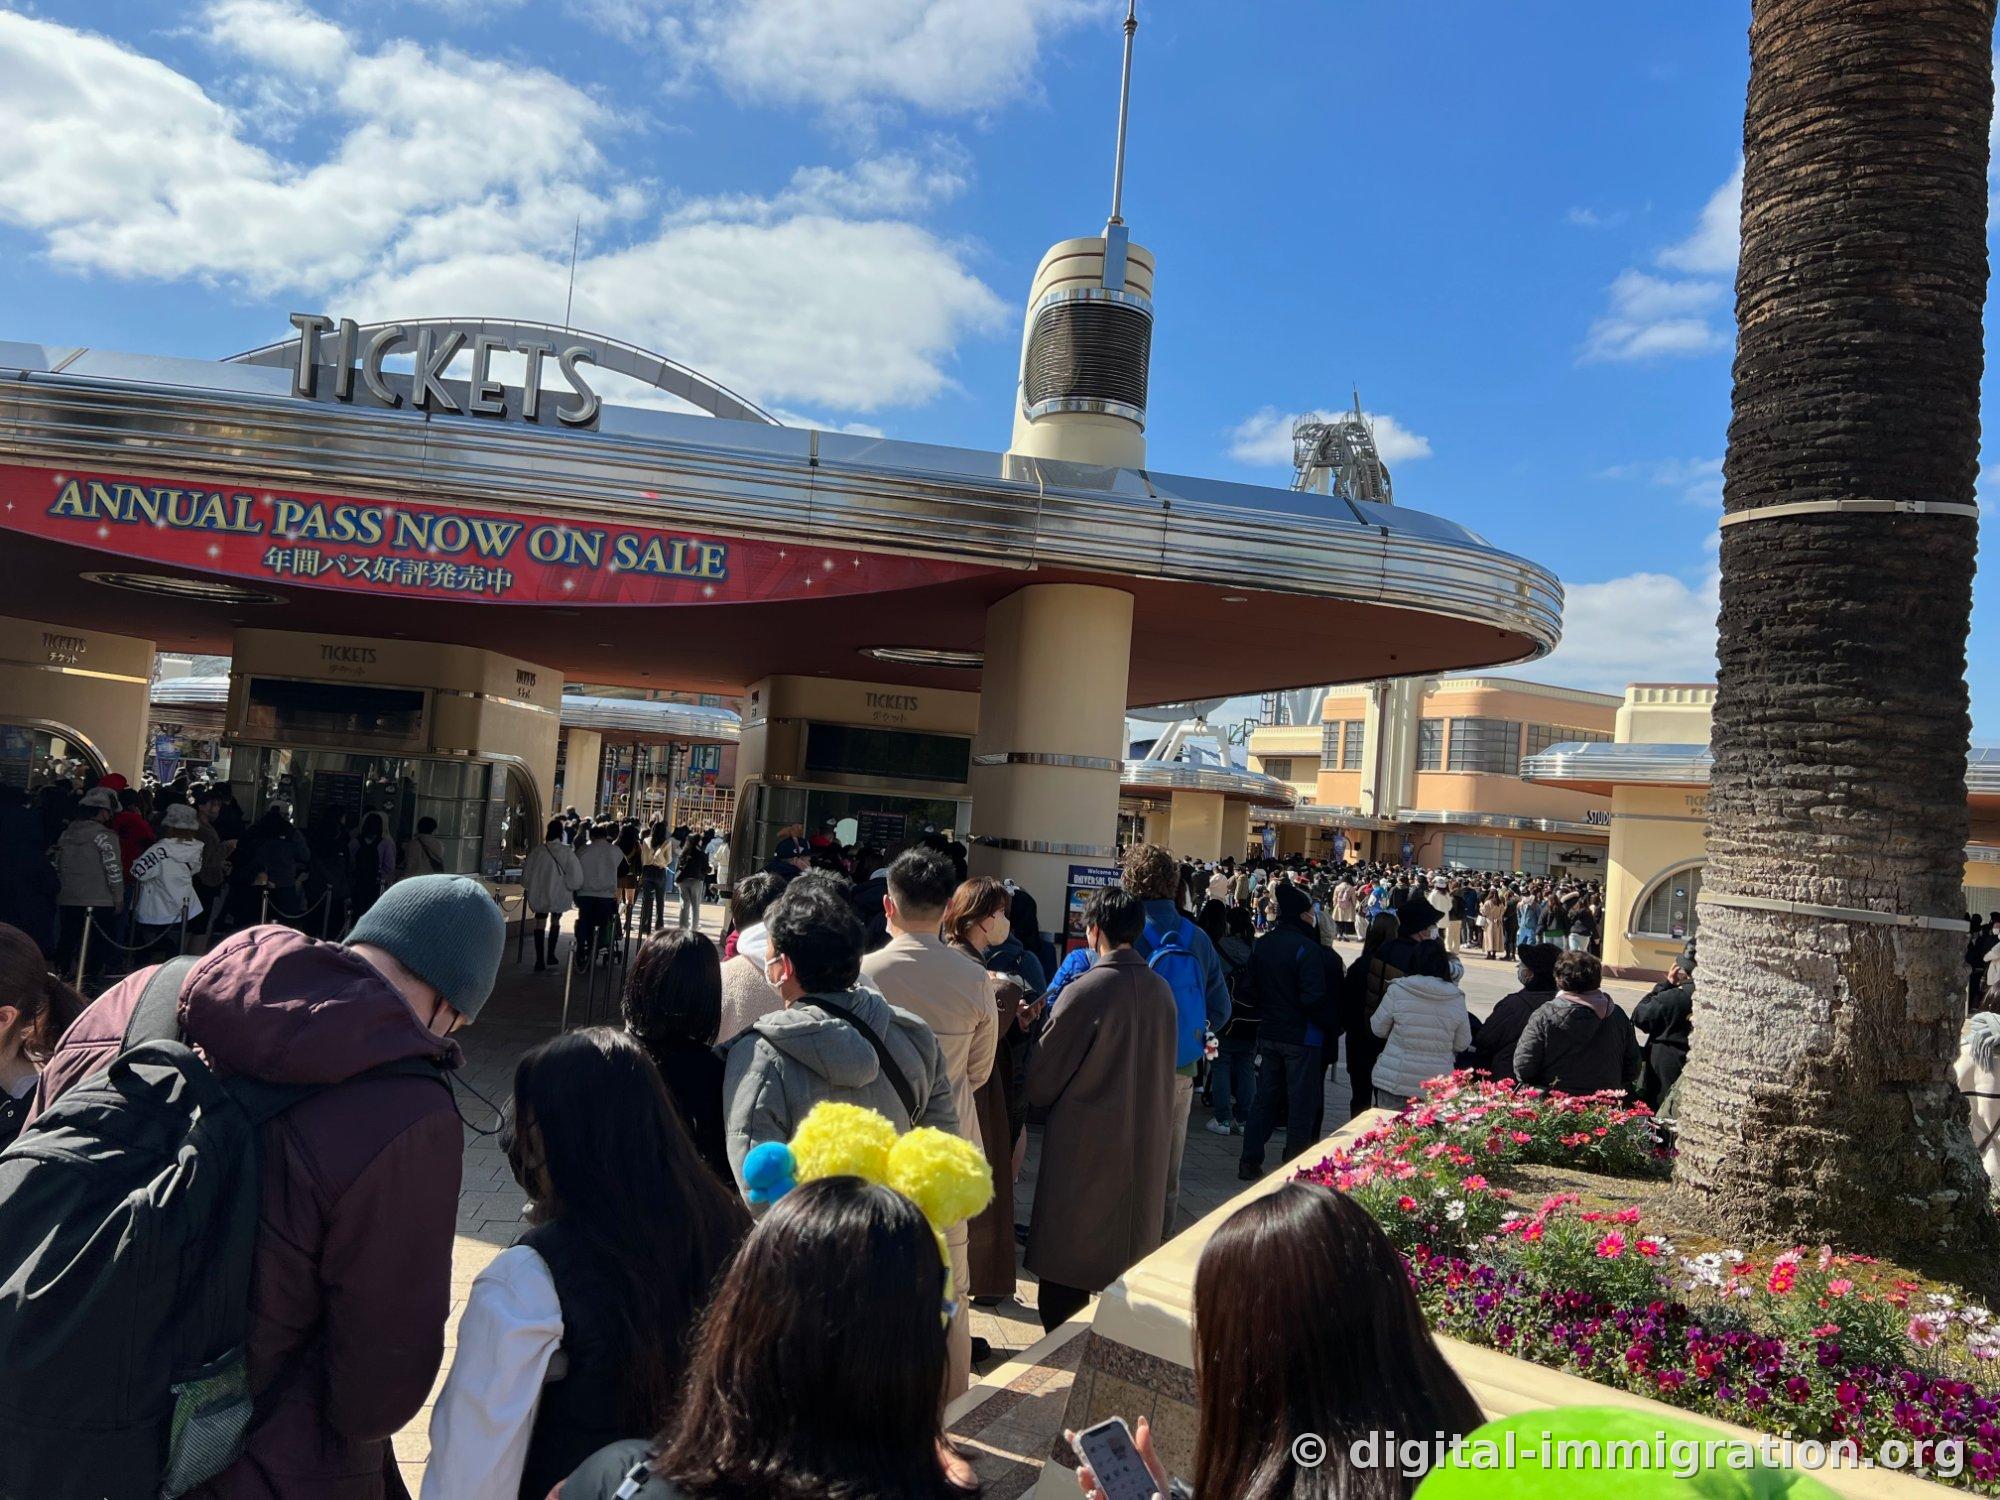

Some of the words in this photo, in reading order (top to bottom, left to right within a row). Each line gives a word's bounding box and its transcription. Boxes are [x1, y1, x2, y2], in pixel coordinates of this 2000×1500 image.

[290, 313, 599, 426] TICKETS
[49, 479, 263, 534] ANNUAL
[271, 498, 384, 544] PASS
[391, 512, 523, 557] NOW
[529, 525, 606, 567] ON
[613, 533, 727, 580] SALE
[264, 546, 513, 594] 年間パス好評発売中
[42, 632, 87, 653] TICKETS
[320, 644, 377, 664] TICKETS
[865, 692, 918, 711] TICKETS
[1073, 874, 1106, 886] UNIVERSAL
[1087, 868, 1112, 876] Welcome
